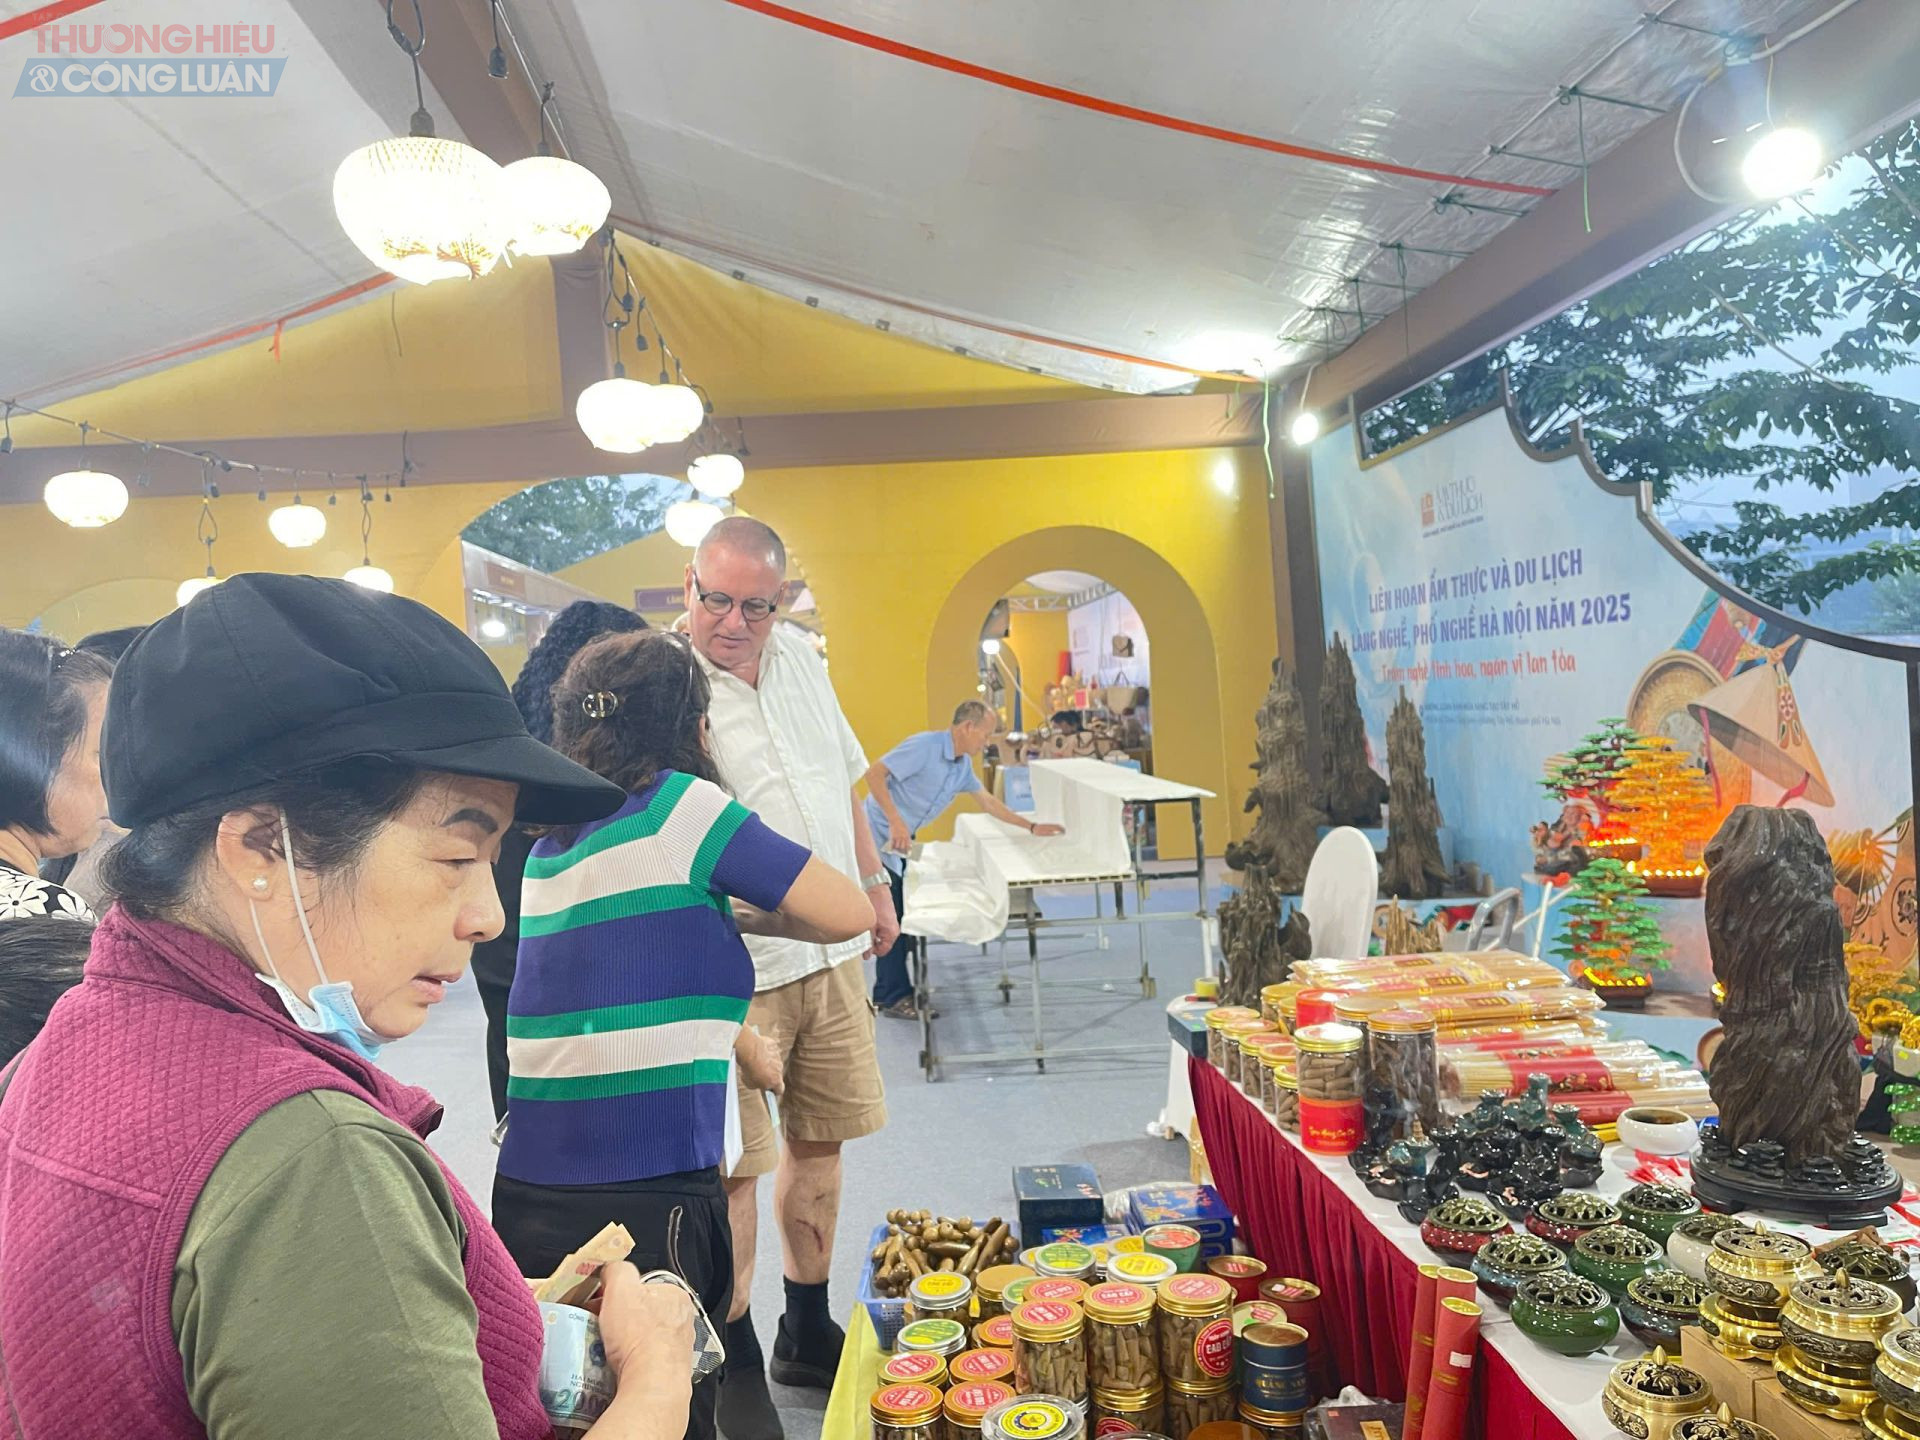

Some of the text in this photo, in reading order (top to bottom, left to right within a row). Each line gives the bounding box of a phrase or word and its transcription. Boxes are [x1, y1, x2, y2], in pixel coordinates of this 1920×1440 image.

[1369, 585, 1392, 613] LIÊN
[1394, 582, 1426, 610] HOAN
[1450, 566, 1488, 600] THỰC
[1491, 557, 1511, 590] VÀ
[1514, 558, 1537, 586] DU
[1542, 548, 1582, 586] LỊCH
[1413, 609, 1437, 645] PHỐ
[1440, 604, 1476, 642] NGHỀ
[1479, 605, 1500, 638] HÀ
[1503, 600, 1531, 640] NỘI
[1535, 596, 1576, 631] NĂM
[1580, 592, 1631, 626] 2025
[1526, 651, 1548, 674] lan
